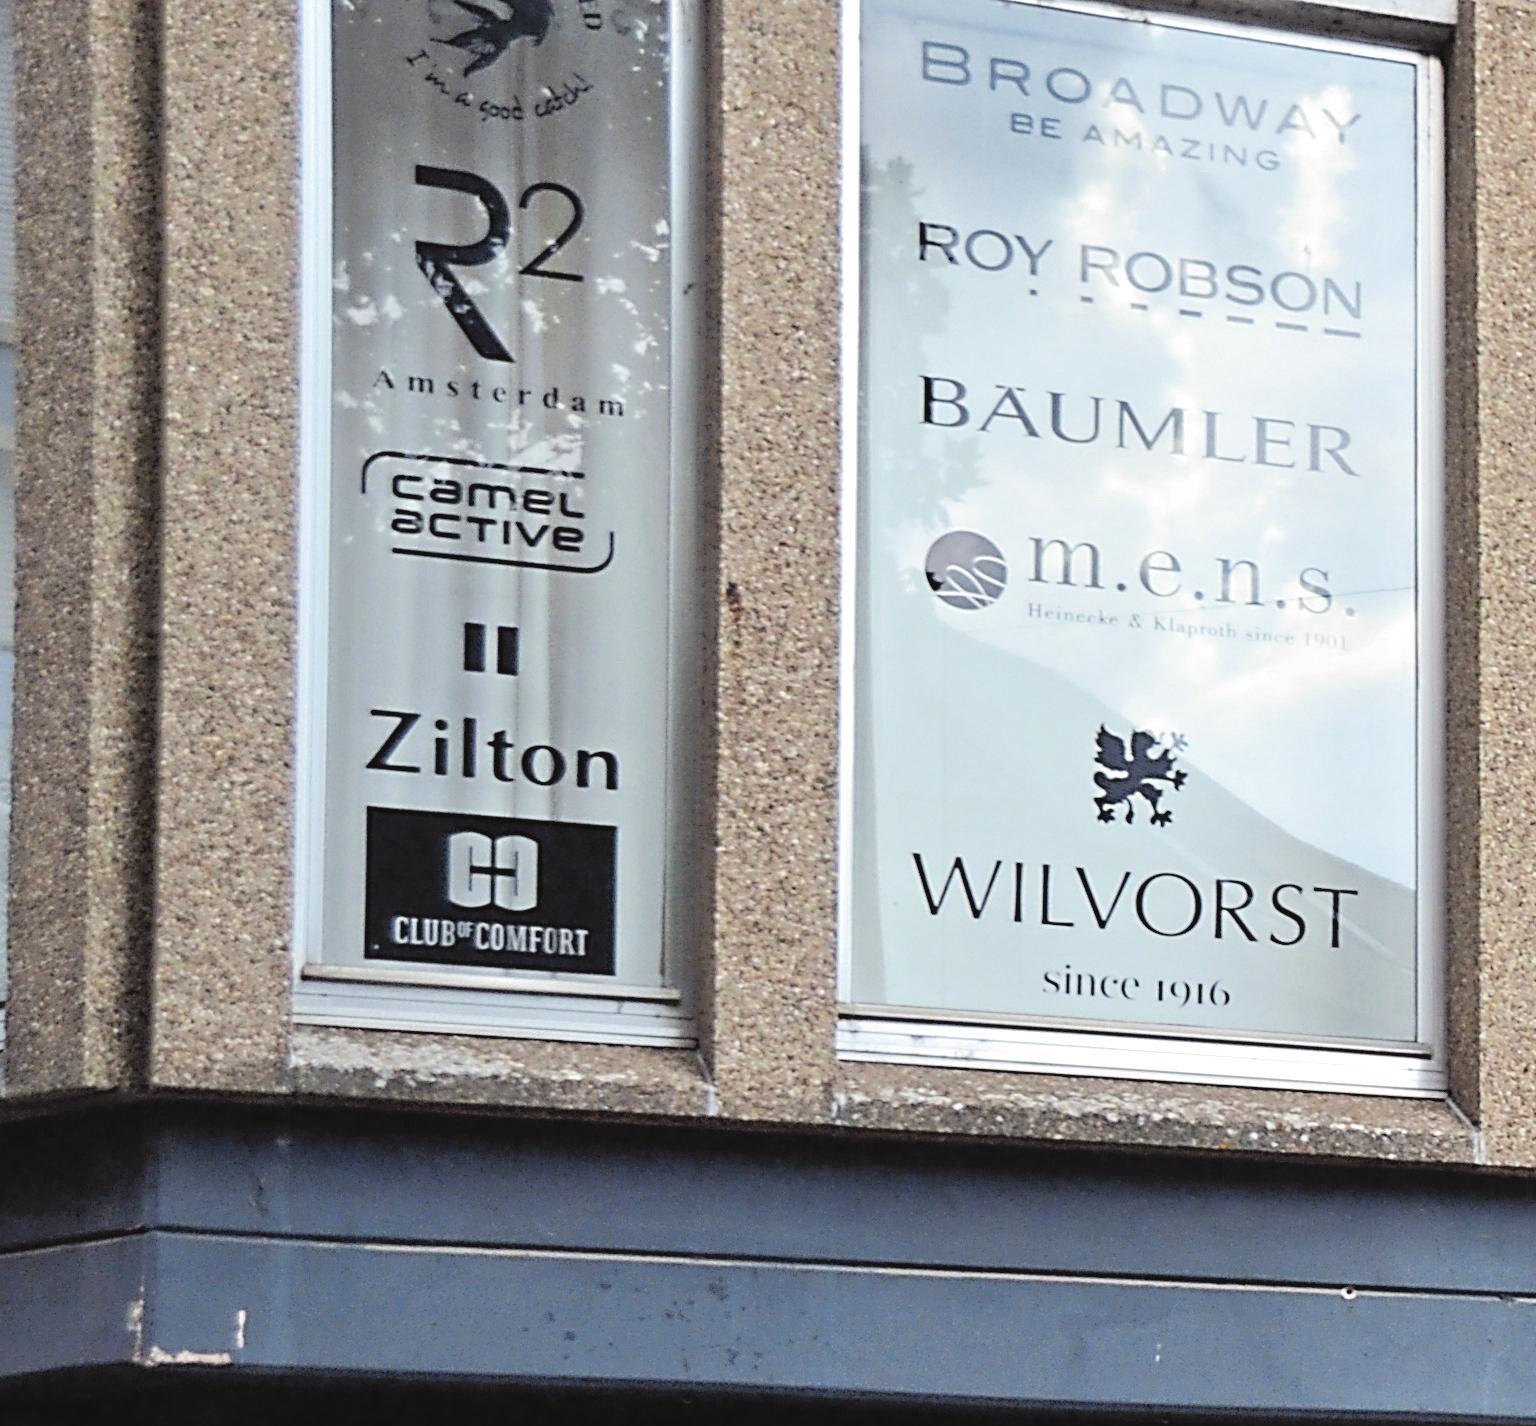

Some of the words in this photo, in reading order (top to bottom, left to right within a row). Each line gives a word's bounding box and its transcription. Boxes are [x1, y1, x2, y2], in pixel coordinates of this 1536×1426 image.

[479, 95, 524, 122] good
[921, 41, 1364, 145] BROADWAY
[1010, 113, 1061, 140] BE
[1084, 124, 1282, 171] AMAZING
[918, 221, 1053, 276] ROY
[1080, 244, 1363, 320] ROBSON
[373, 368, 626, 419] Amsterdam
[918, 374, 1363, 477] BÄUMLER
[1027, 535, 1358, 618] m.e.n.s.
[1028, 602, 1118, 626] Heinecke
[1128, 614, 1143, 628] &
[366, 709, 620, 791] Zilton
[912, 852, 1358, 949] WILVORST
[393, 916, 456, 947] CLUB
[457, 921, 474, 938] OF
[475, 921, 589, 956] COMFORT
[1042, 964, 1140, 1001] since
[1156, 978, 1232, 1009] 1916
